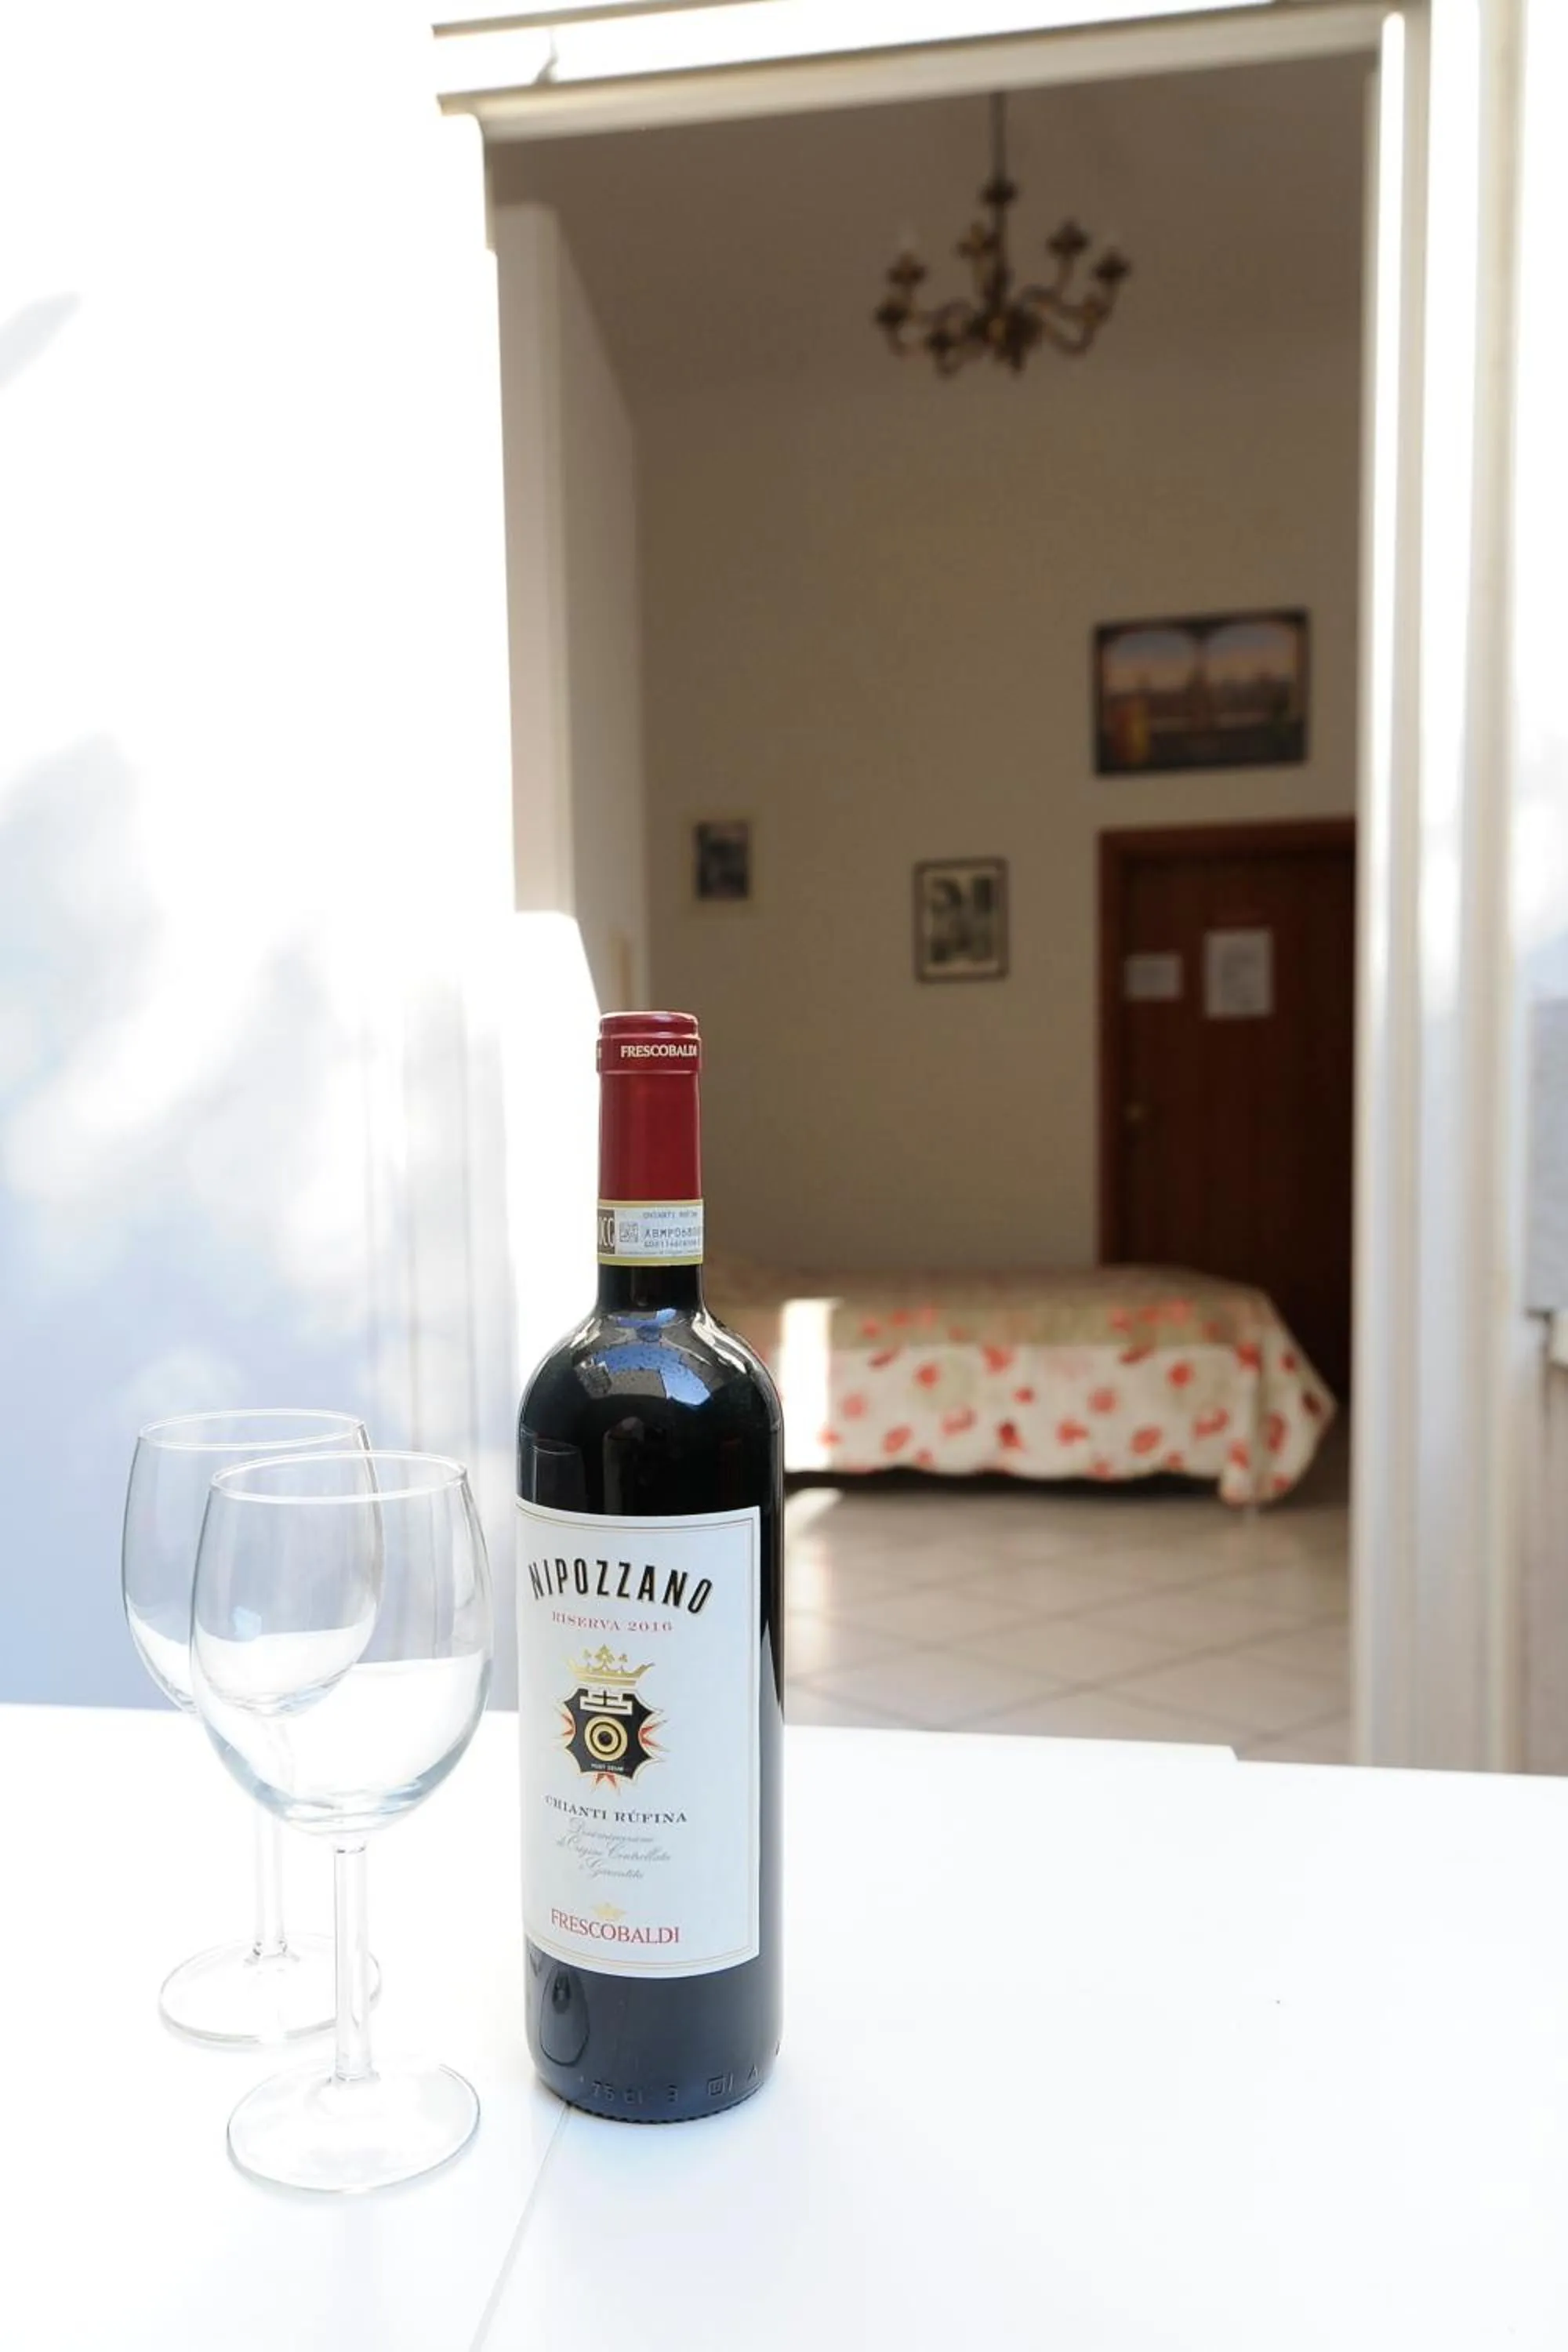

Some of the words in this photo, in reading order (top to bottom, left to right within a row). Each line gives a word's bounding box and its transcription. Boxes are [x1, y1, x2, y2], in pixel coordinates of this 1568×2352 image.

[620, 1044, 698, 1058] FRESCOBALDI
[528, 1557, 713, 1614] NIPOZZANO
[552, 1610, 620, 1632] RISERVA
[627, 1621, 673, 1632] 2016
[544, 1795, 608, 1820] CHIANTI
[550, 1907, 680, 1944] FRESCOBALDI
